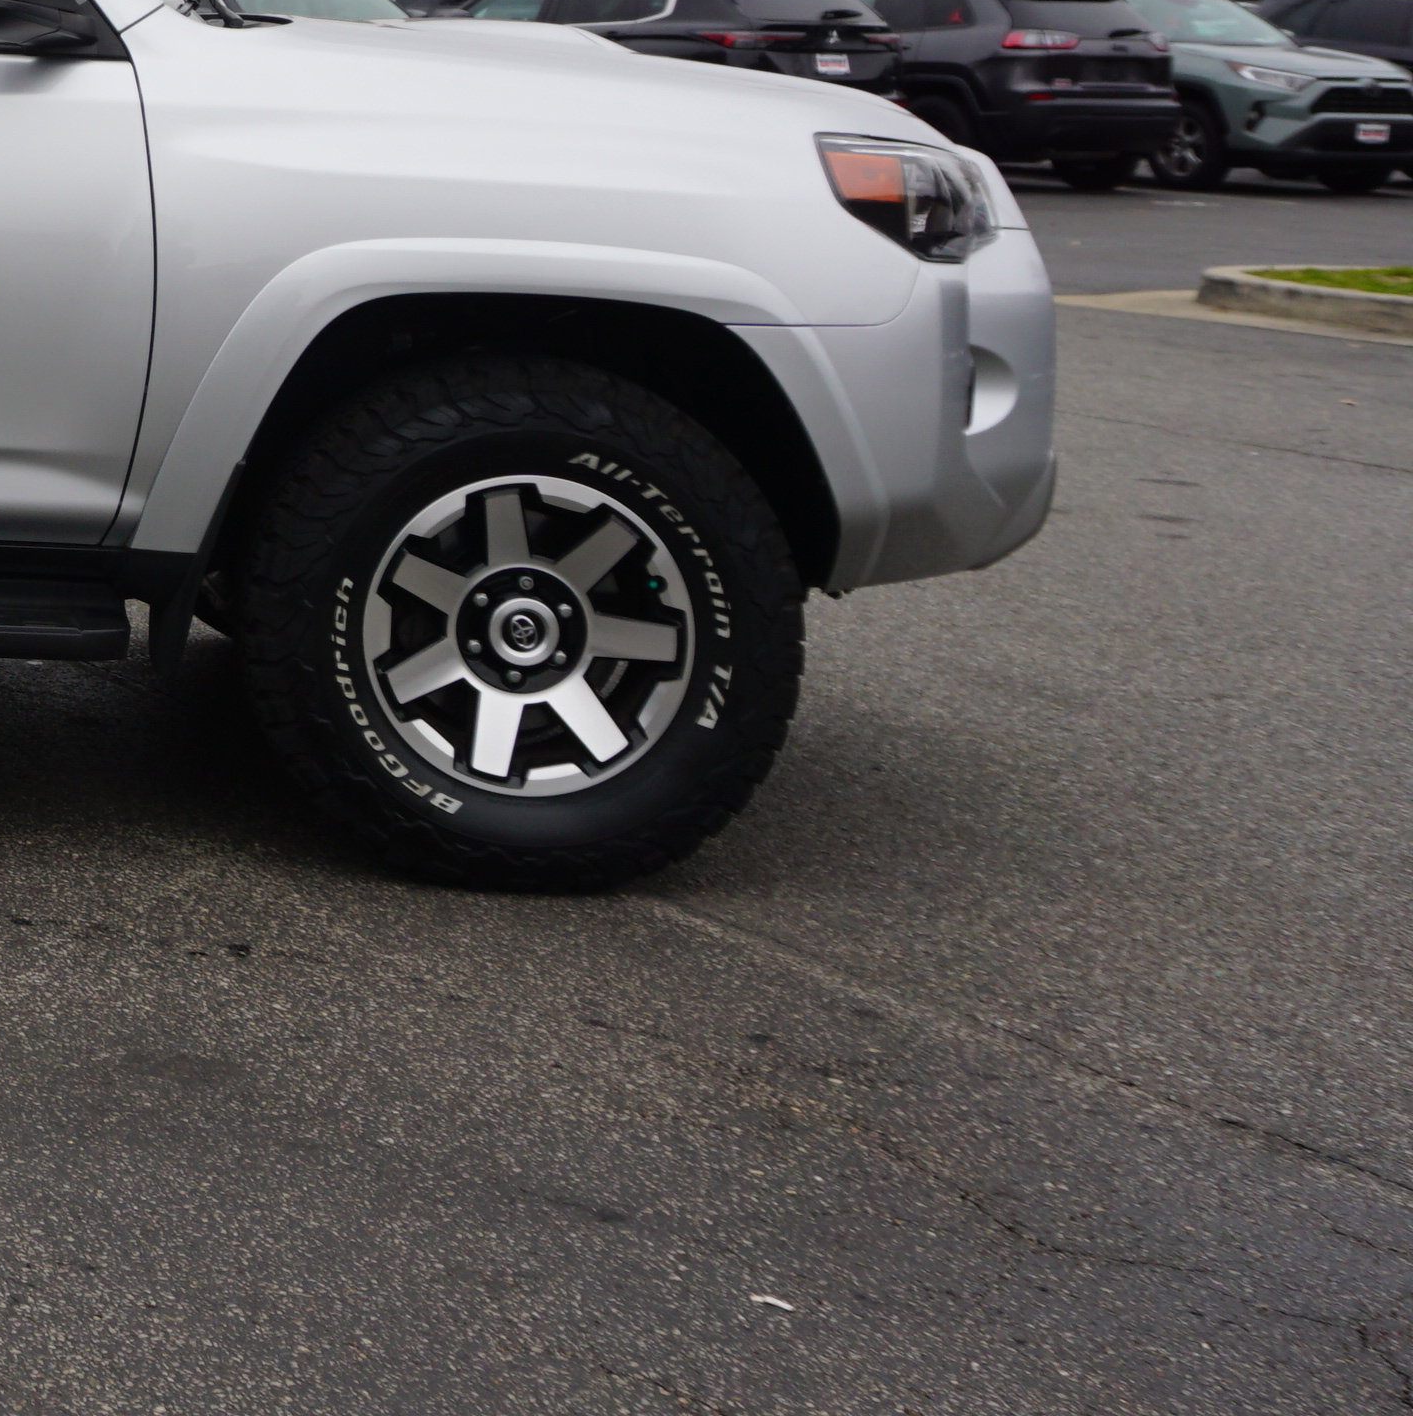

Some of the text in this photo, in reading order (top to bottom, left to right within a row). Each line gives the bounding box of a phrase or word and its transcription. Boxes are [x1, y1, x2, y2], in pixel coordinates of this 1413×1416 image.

[330, 576, 464, 815] BFGoodrich
[567, 451, 733, 730] All-Terrain T/A
